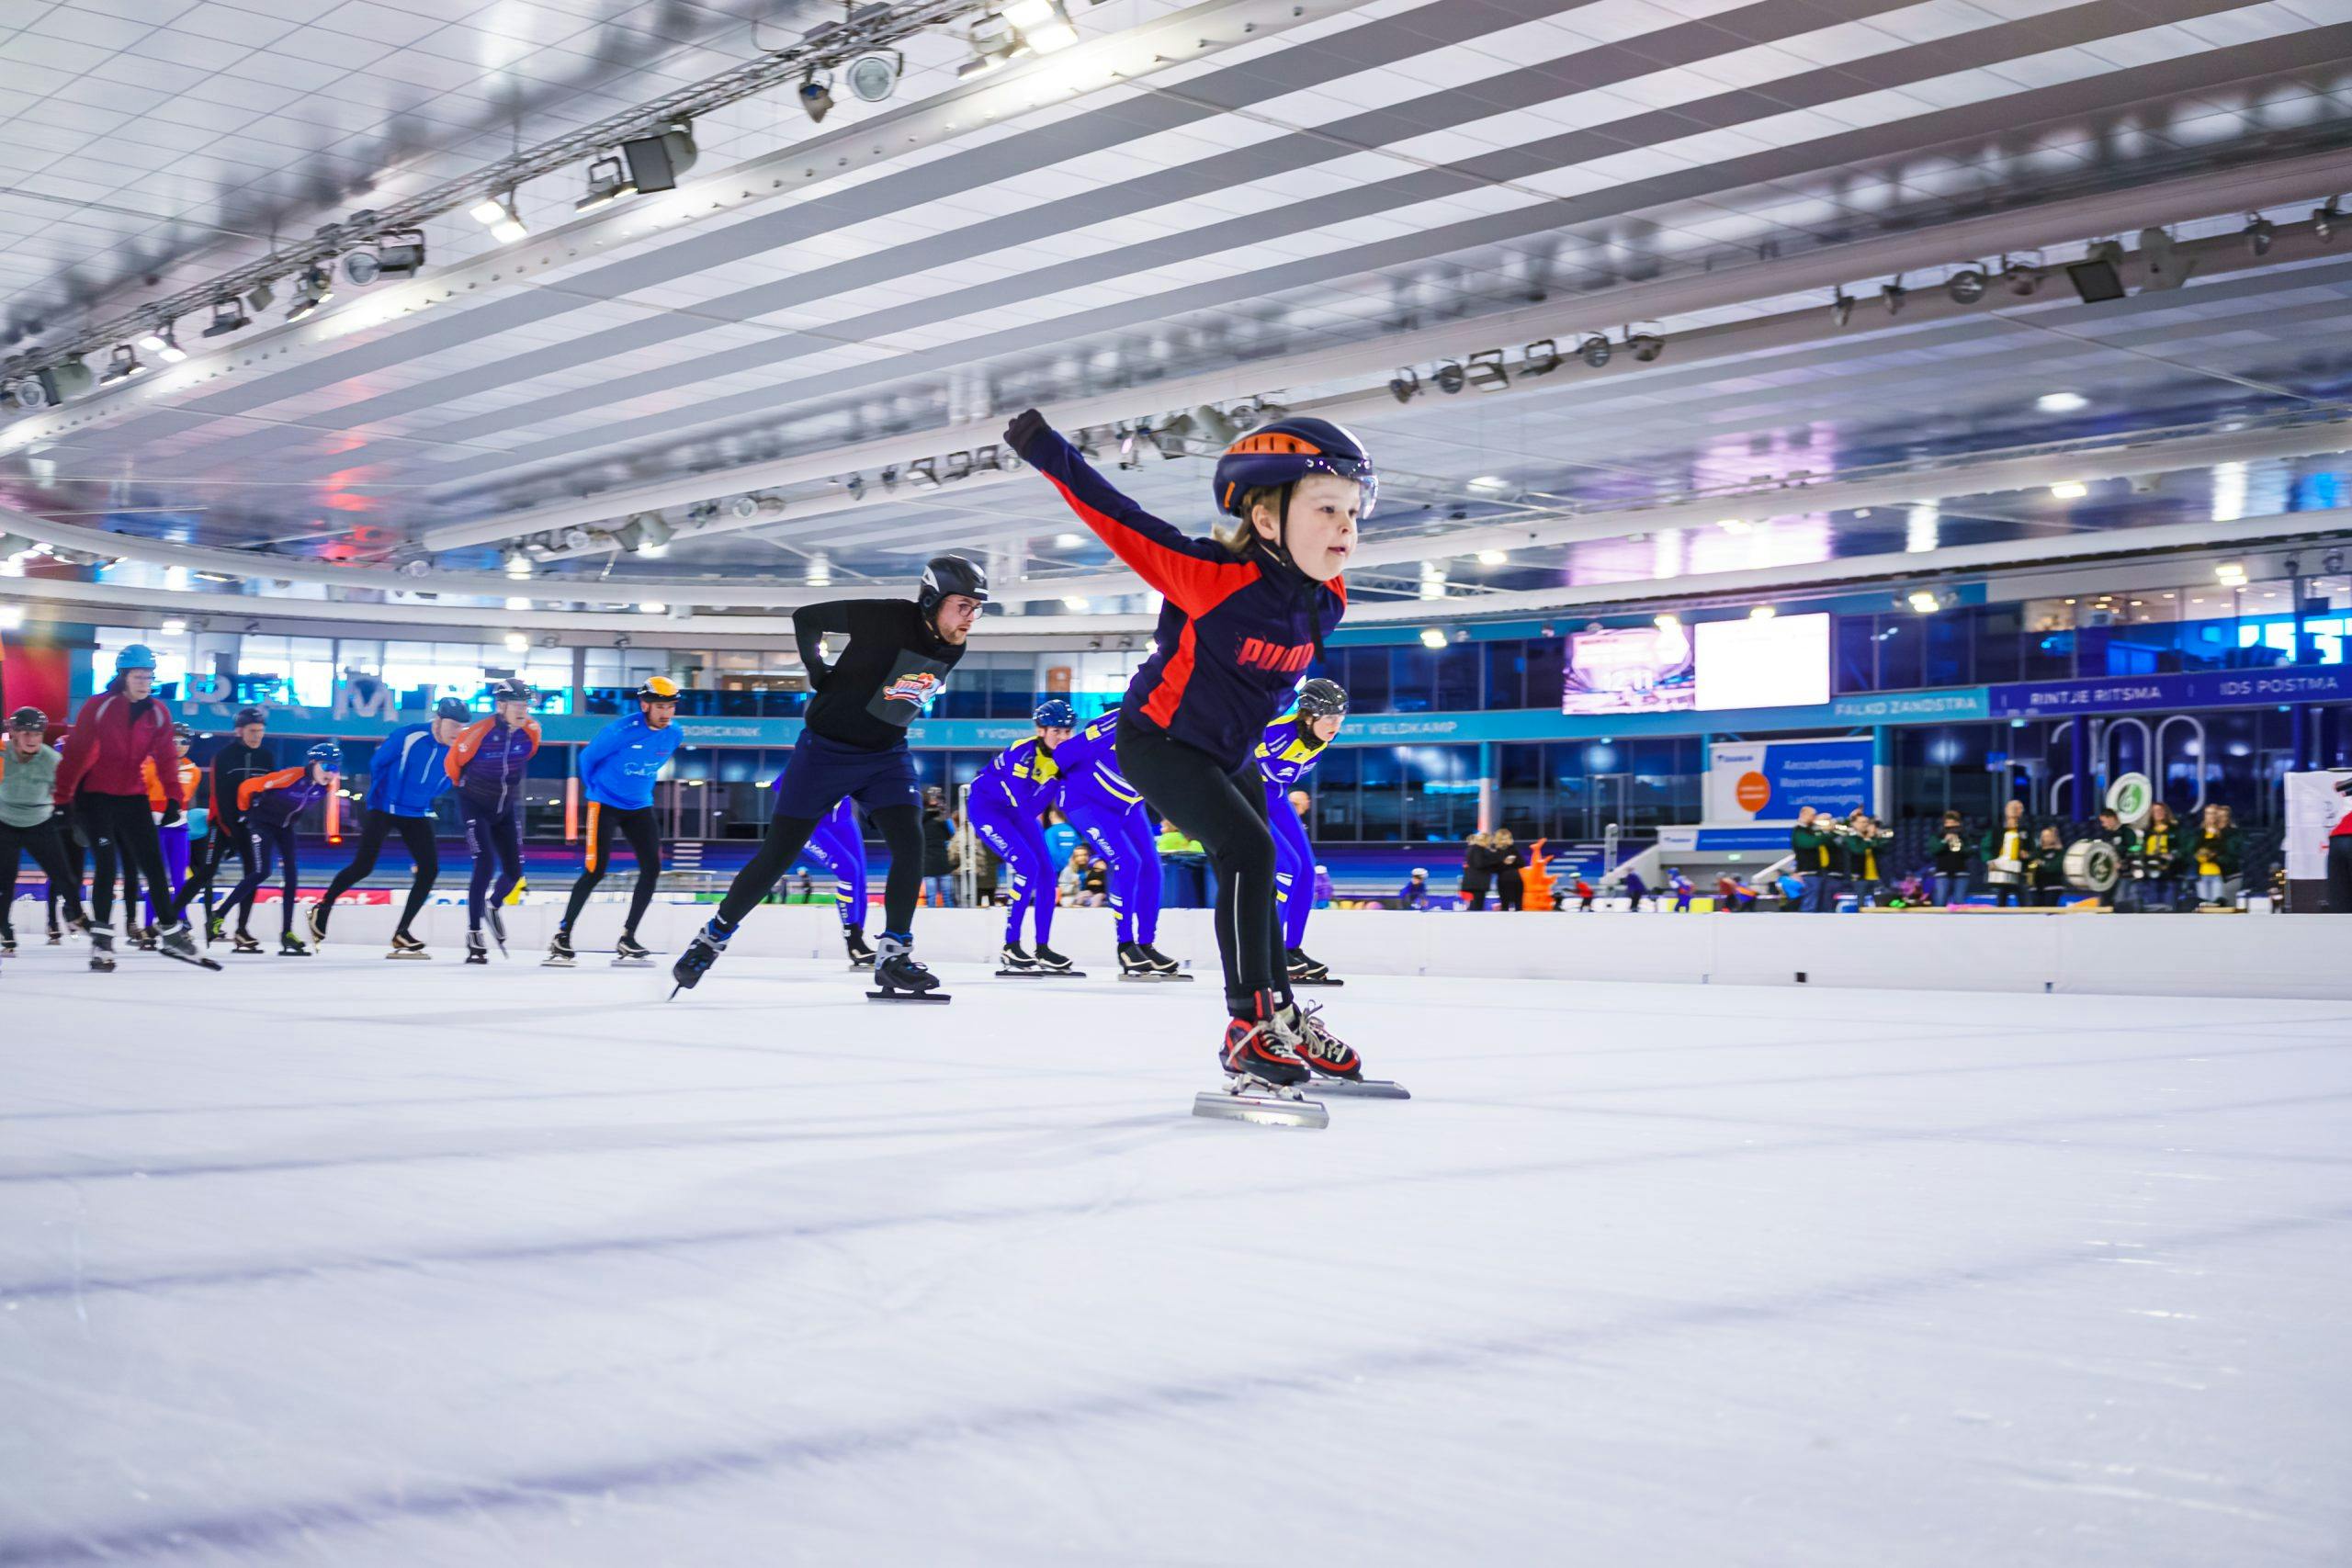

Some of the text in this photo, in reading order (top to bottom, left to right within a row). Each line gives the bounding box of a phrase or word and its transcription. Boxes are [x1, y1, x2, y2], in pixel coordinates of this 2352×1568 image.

[1236, 637, 1315, 672] PUMA
[2220, 676, 2338, 695] IDS POSTMA
[2030, 686, 2162, 705] RINTJE RITSMA
[1339, 723, 1364, 735] ART
